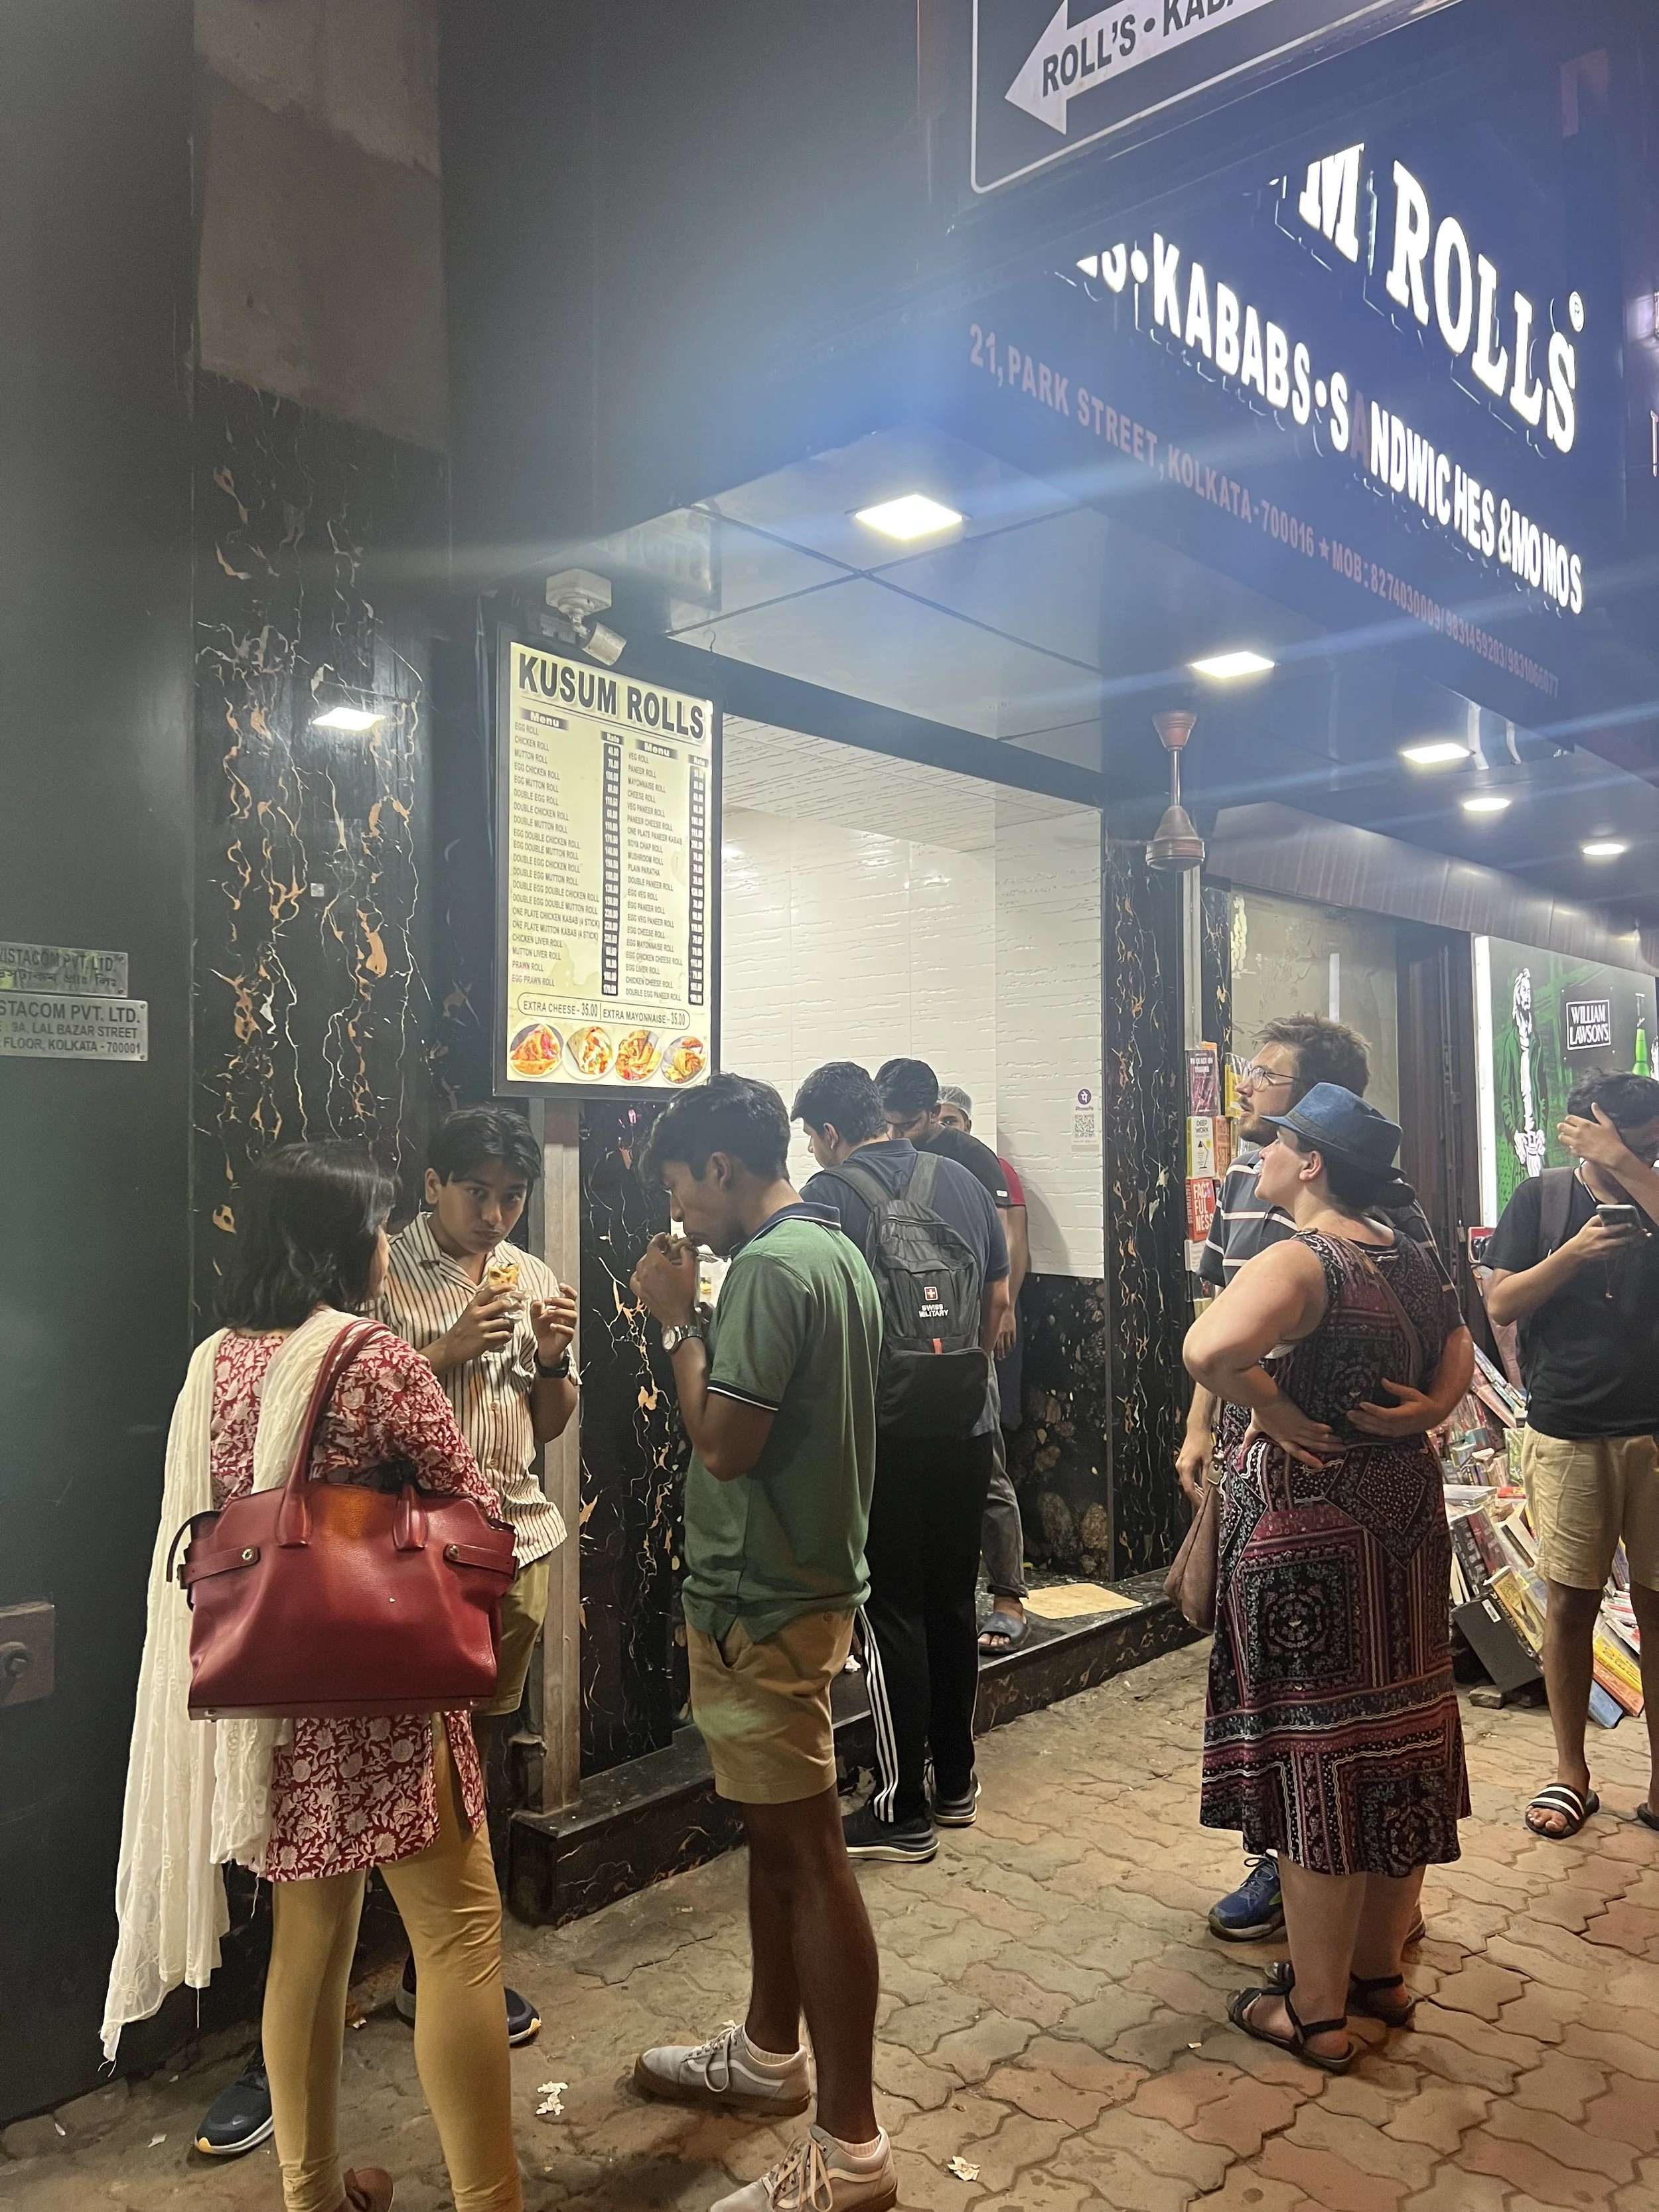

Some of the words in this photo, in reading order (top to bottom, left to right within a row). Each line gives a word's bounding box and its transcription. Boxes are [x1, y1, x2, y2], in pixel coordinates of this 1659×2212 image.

[1042, 14, 1136, 98] ROLL'S
[519, 652, 616, 715] KUSUM
[627, 685, 703, 740] ROLLS
[515, 721, 526, 732] EGG
[526, 725, 538, 735] ROLL
[530, 711, 559, 728] Menu
[514, 735, 536, 748] CHICKEN
[537, 741, 549, 751] ROLL
[644, 742, 669, 757] Menu
[514, 748, 535, 761] MUTTON
[536, 753, 547, 764] ROLL
[514, 761, 525, 772] EGG
[526, 765, 547, 777] CHICKEN
[547, 770, 560, 780] ROLL
[514, 775, 524, 785] EGG
[526, 778, 545, 790] MUTTON
[546, 782, 559, 793] ROLL
[514, 788, 534, 800] DOUBLE
[534, 793, 545, 803] EGG
[546, 796, 559, 806] ROLL
[514, 802, 534, 814] DOUBLE
[534, 806, 556, 818] CHICKEN
[557, 811, 569, 821] ROLL
[514, 815, 534, 827] DOUBLE
[534, 819, 554, 831] MUTTON
[555, 824, 567, 834] ROLL
[514, 828, 524, 838] EGG
[525, 830, 545, 842] DOUBLE
[545, 835, 567, 847] CHICKEN
[568, 840, 580, 849] ROLL
[514, 840, 524, 850] EGG
[525, 842, 545, 854] DOUBLE
[545, 846, 565, 858] MUTTON
[567, 850, 579, 860] ROLL
[513, 853, 533, 865] DOUBLE
[534, 857, 545, 867] EGG
[545, 859, 567, 871] CHICKEN
[568, 863, 580, 873] ROLL
[512, 867, 533, 878] DOUBLE
[534, 870, 544, 880] EGG
[545, 873, 565, 884] MUTTON
[566, 876, 578, 886] ROLL
[512, 880, 533, 891] DOUBLE
[534, 883, 544, 893] EGG
[545, 885, 565, 897] DOUBLE
[565, 889, 586, 900] CHICKEN
[587, 893, 599, 903] ROLL
[512, 893, 532, 905] DOUBLE
[534, 897, 544, 906] EGG
[545, 899, 565, 909] DOUBLE
[565, 902, 585, 913] MUTTON
[585, 905, 598, 915] ROLL
[512, 907, 523, 916] ONE
[524, 909, 539, 919] PLATE
[540, 911, 561, 922] CHICKEN
[512, 920, 523, 929] ONE
[524, 921, 539, 932] PLATE
[540, 924, 560, 934] MUTTON
[512, 933, 534, 944] CHICKEN
[550, 938, 564, 948] ROLL
[512, 946, 533, 957] MUTTON
[549, 951, 561, 960] ROLL
[531, 962, 543, 972] ROLL
[512, 974, 523, 983] EGG
[542, 978, 555, 987] ROLL
[71, 1005, 104, 1022] PVT.
[109, 1007, 140, 1023] LTD.
[524, 1001, 546, 1011] EXTRA
[581, 1002, 597, 1017] 35.00
[603, 1009, 624, 1019] EXTRA
[671, 1012, 685, 1025] 35.00
[1571, 1004, 1605, 1024] WILLIAM
[33, 1023, 54, 1035] LAL
[57, 1025, 94, 1036] BAZAR
[98, 1027, 138, 1039] STREET
[48, 1039, 98, 1051] KOLKATA
[918, 1309, 948, 1317] MILITARY
